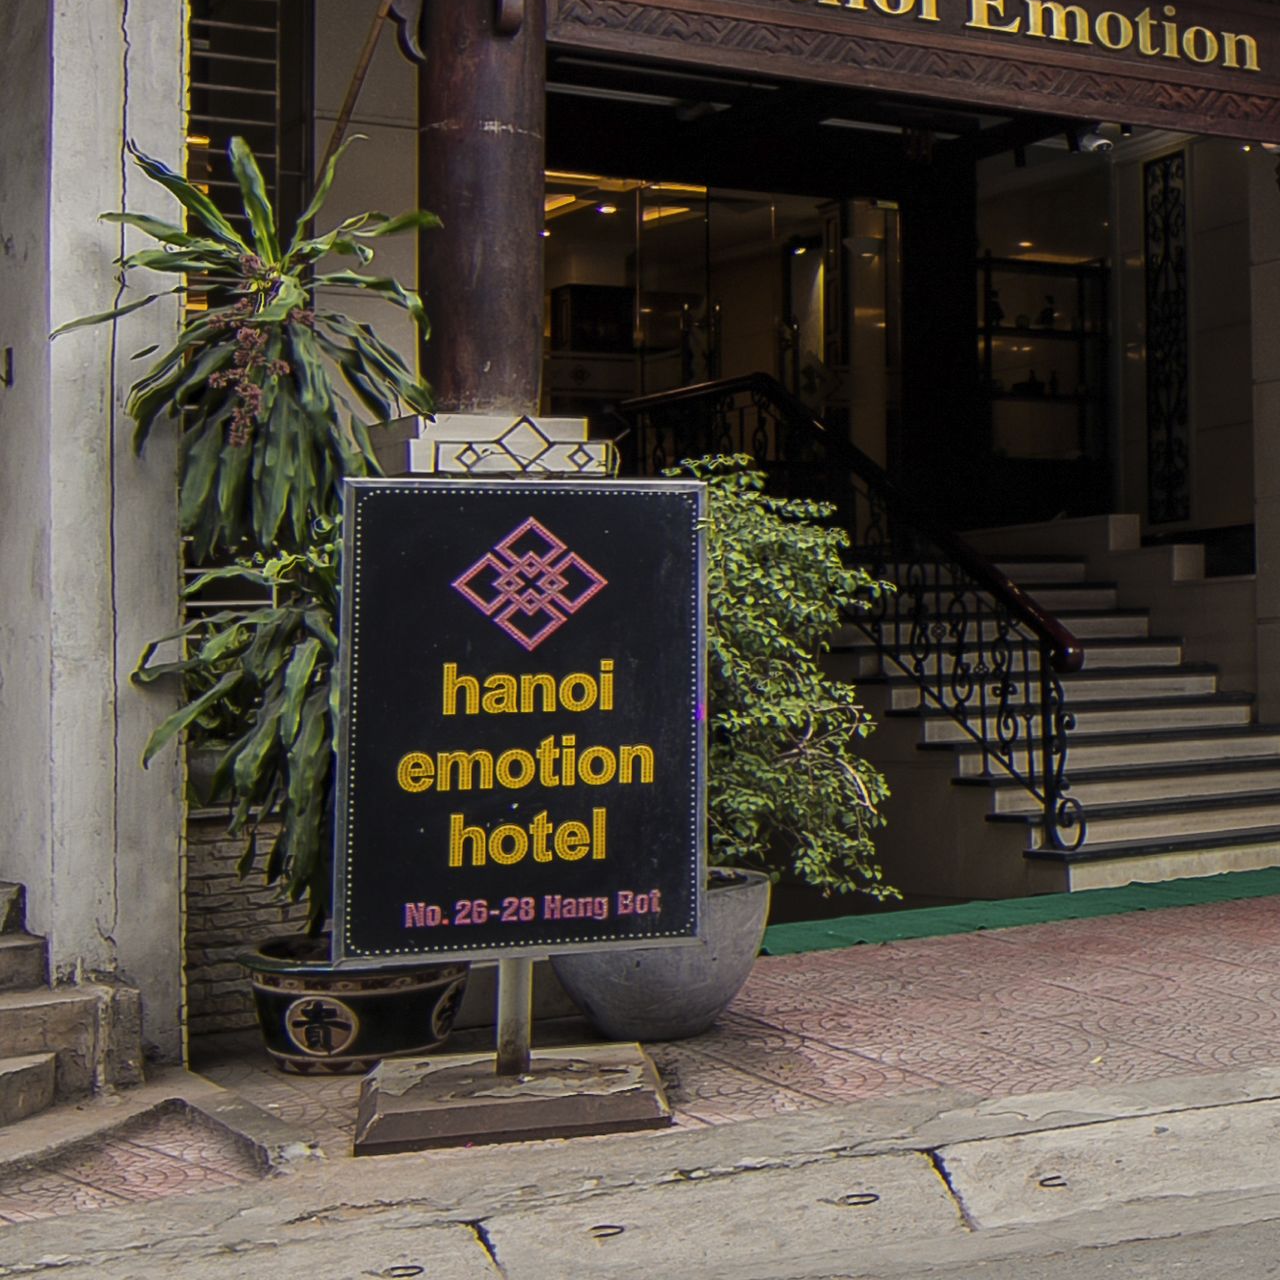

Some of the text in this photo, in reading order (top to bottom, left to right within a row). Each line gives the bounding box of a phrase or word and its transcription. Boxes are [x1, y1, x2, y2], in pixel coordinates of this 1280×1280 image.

[442, 658, 614, 716] hanoi
[397, 735, 655, 793] emotion
[448, 808, 607, 867] hotel
[404, 889, 662, 928] No. 26-28 Hang Bot
